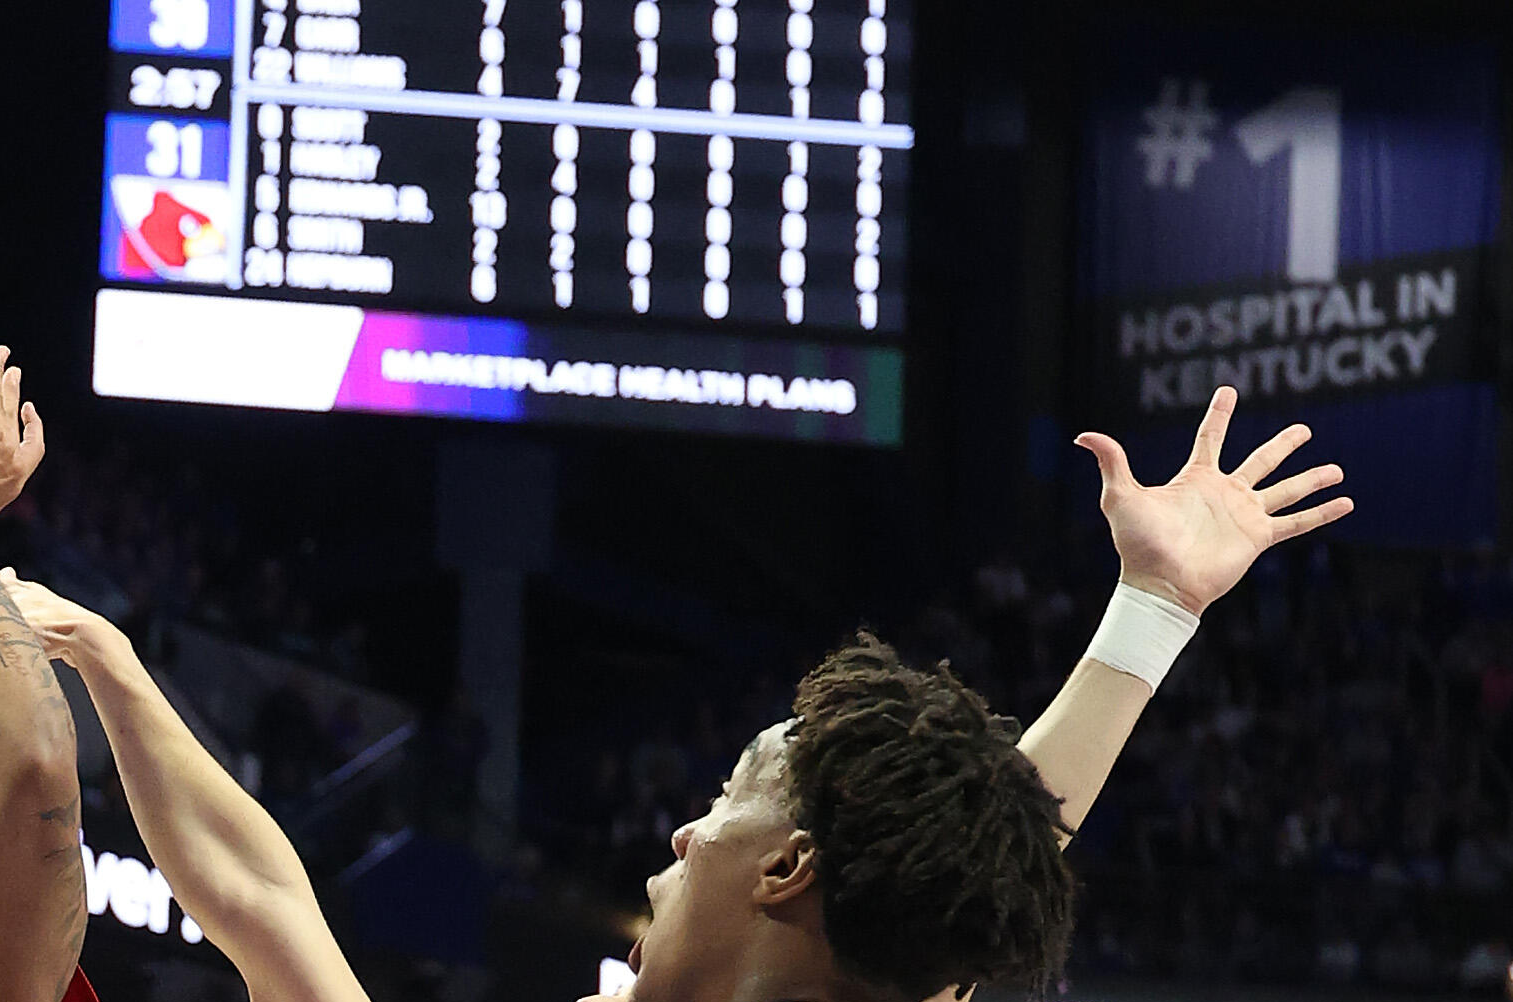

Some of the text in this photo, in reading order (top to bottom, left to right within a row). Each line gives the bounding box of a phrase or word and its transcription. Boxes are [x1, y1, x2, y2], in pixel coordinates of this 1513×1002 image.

[147, 123, 201, 177] 31
[1136, 79, 1341, 283] #1
[1119, 268, 1456, 357] HOSPITAL IN
[1139, 326, 1436, 412] KENTUCKY
